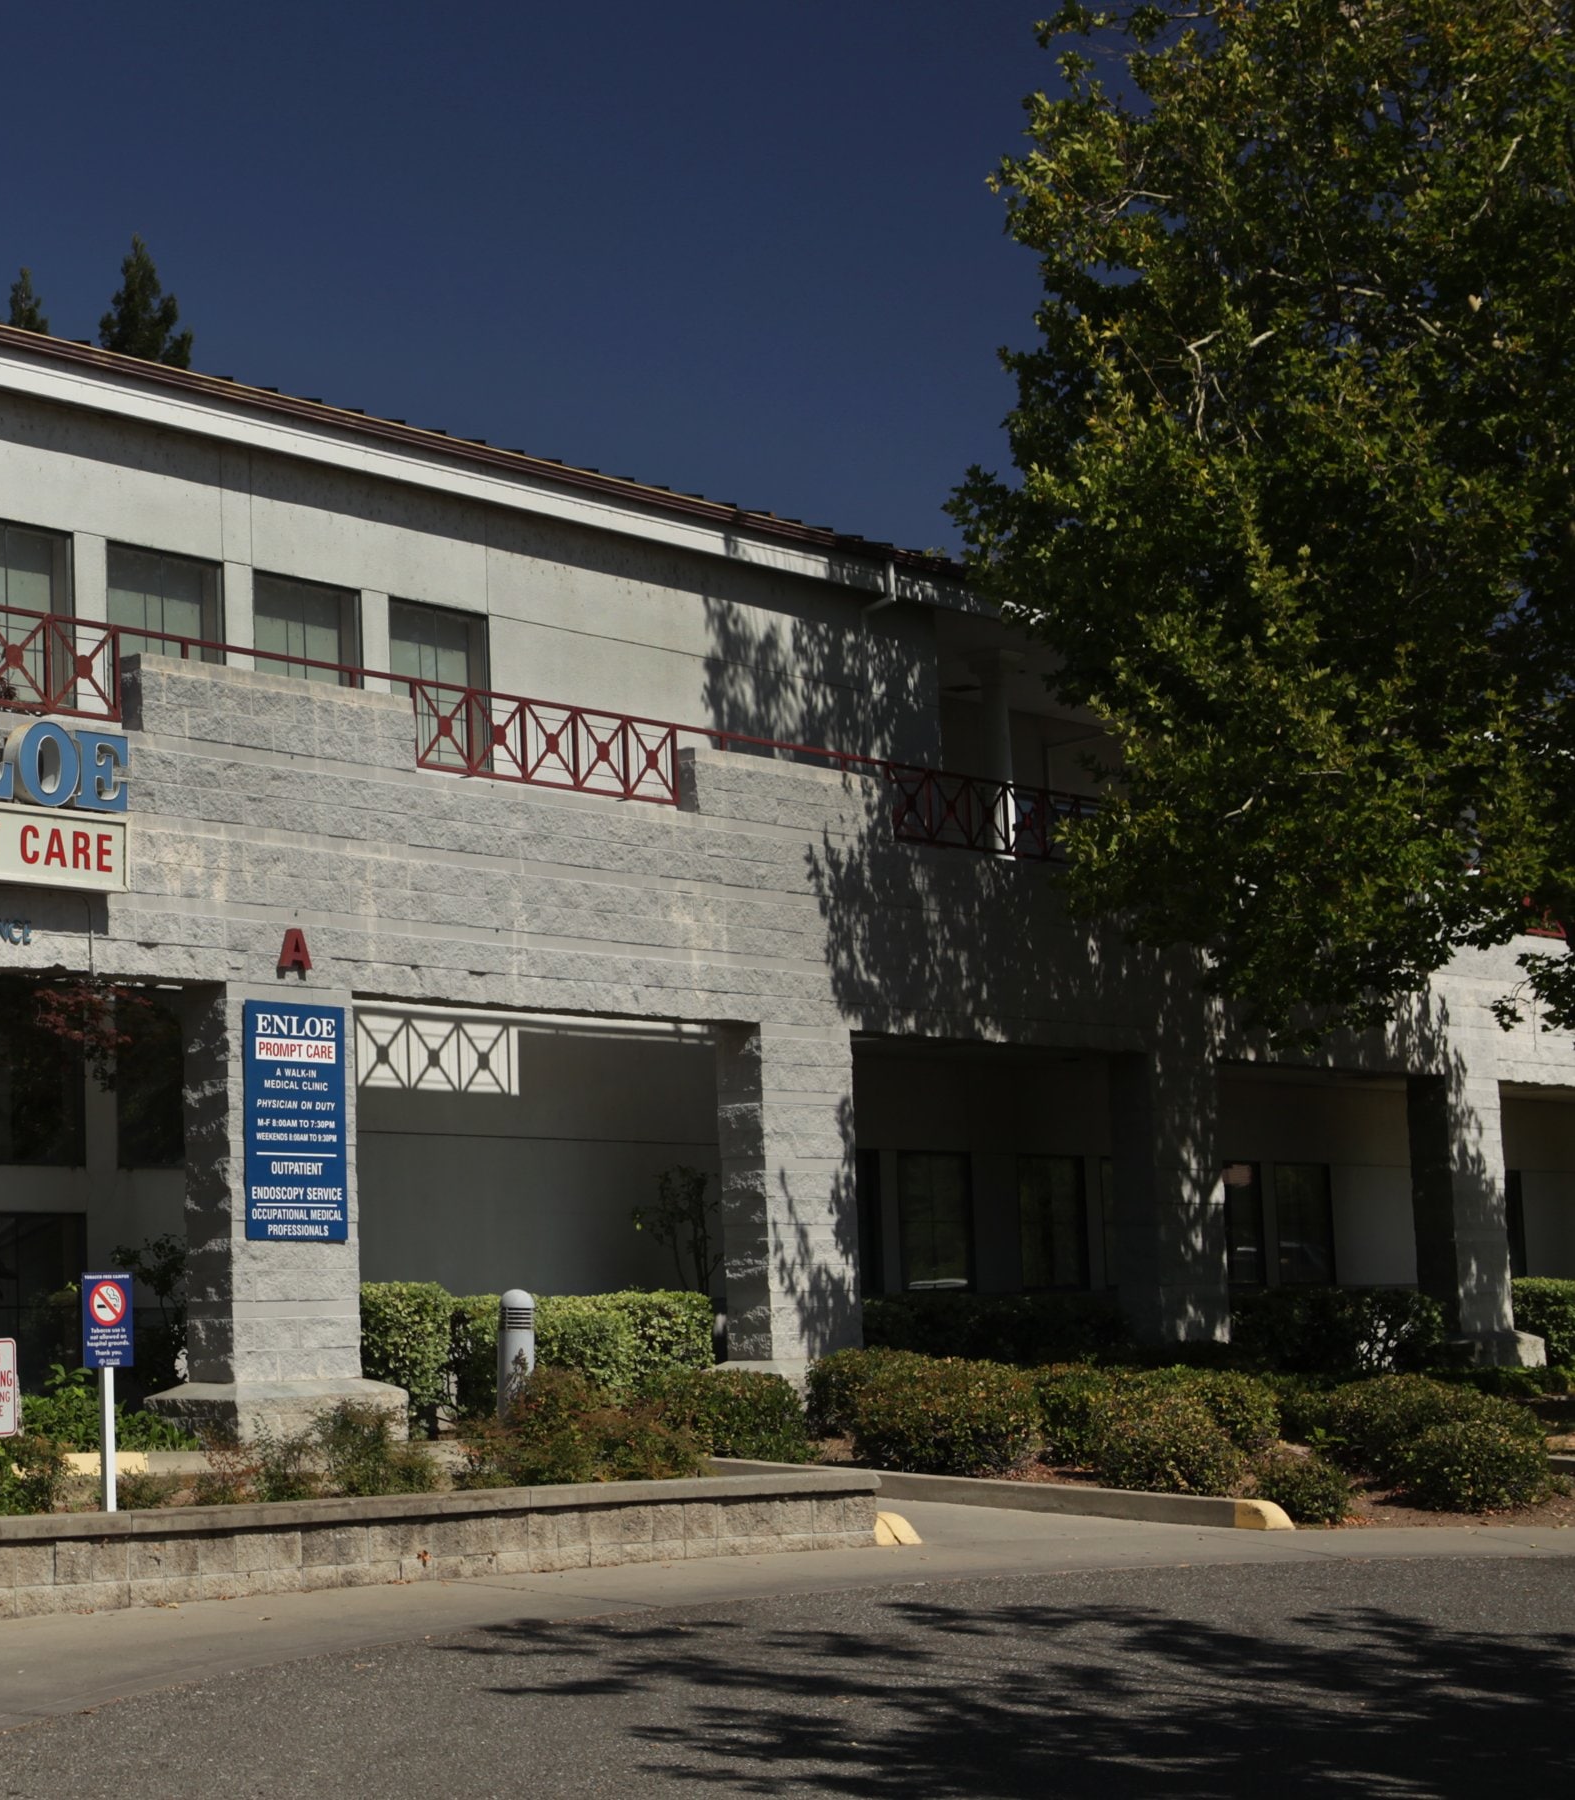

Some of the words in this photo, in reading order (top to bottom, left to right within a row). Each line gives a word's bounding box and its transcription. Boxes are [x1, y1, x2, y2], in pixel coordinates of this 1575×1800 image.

[20, 825, 113, 873] CARE
[277, 928, 313, 971] A
[255, 1013, 336, 1038] ENLOE
[258, 1041, 302, 1058] PROMPT
[306, 1044, 333, 1060] CARE
[275, 1067, 282, 1076] A
[284, 1068, 317, 1078] WALK-IN
[264, 1079, 299, 1090] MEDICAL
[302, 1081, 329, 1092] CLINIC
[256, 1098, 298, 1110] PHYSICIAN
[300, 1101, 313, 1110] ON
[315, 1101, 336, 1111] DUTY
[257, 1118, 270, 1127] M-F
[272, 1118, 297, 1128] 8:00AM
[299, 1119, 309, 1128] TO
[310, 1120, 336, 1129] 7:30PM
[256, 1132, 288, 1141] WEEKENDS
[309, 1133, 317, 1142] TO
[271, 1161, 323, 1175] OUTPATIENT
[251, 1186, 304, 1200] ENDOSCOPY
[306, 1187, 343, 1201] SERVICE
[251, 1208, 308, 1220] OCCUPATIONAL
[310, 1209, 343, 1221] MEDICAL
[267, 1224, 329, 1236] PROFESSIONALS
